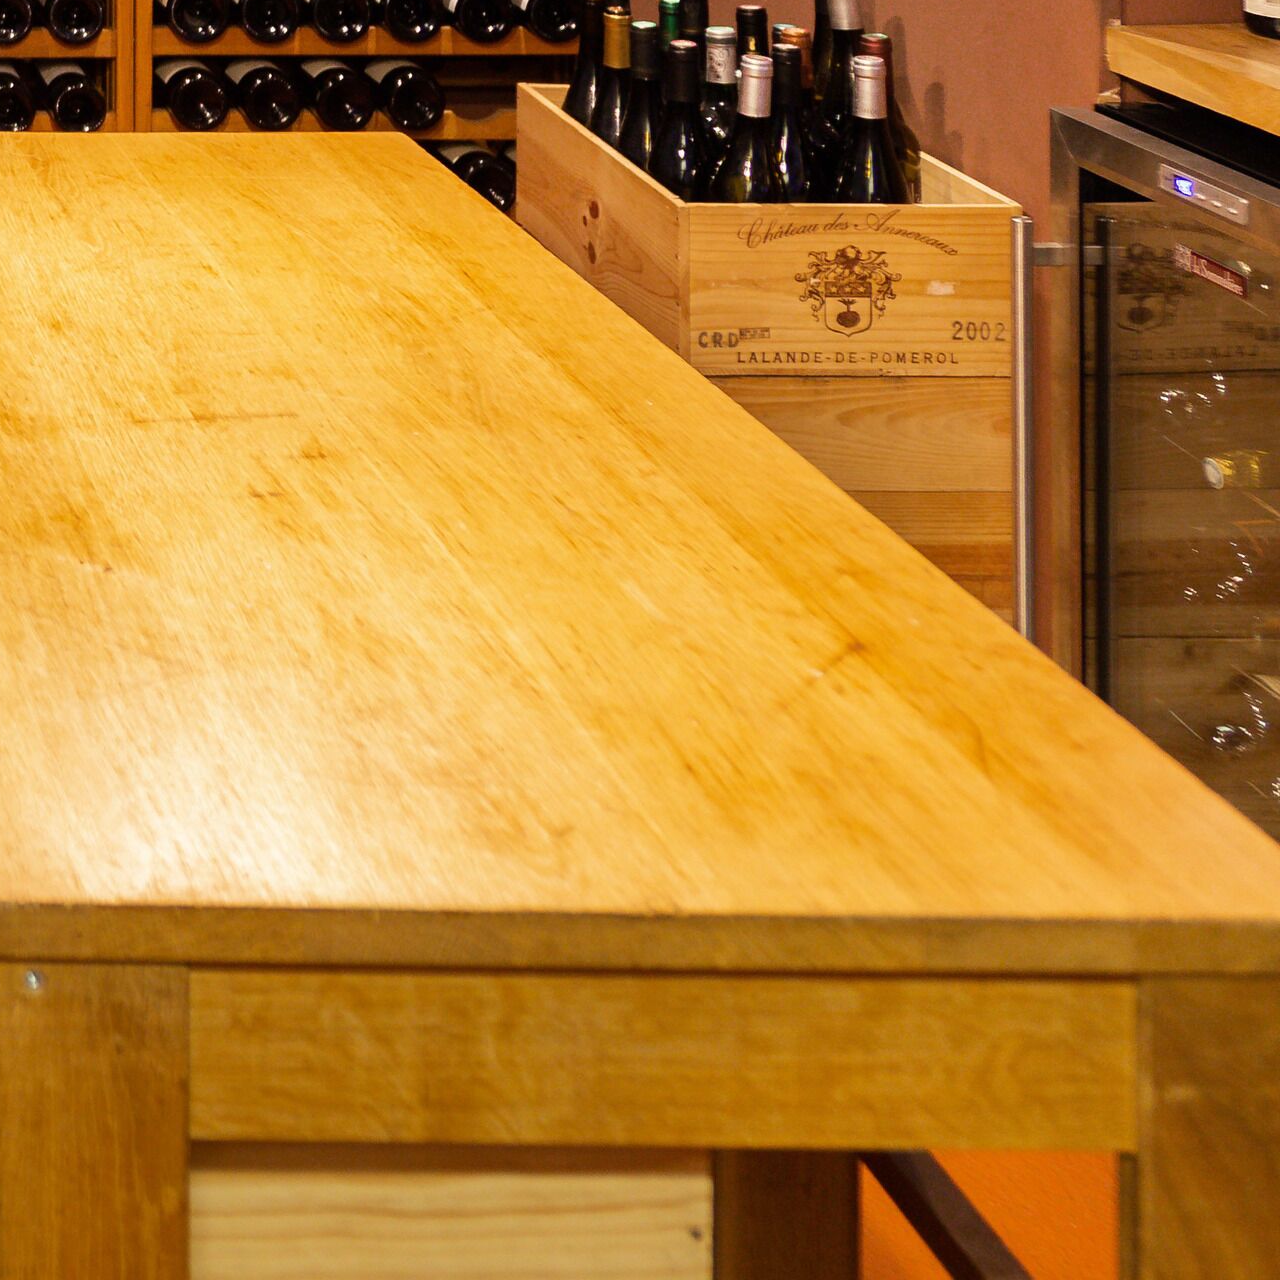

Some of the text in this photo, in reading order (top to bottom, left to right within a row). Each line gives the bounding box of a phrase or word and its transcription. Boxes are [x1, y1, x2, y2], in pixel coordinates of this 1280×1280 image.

[737, 217, 819, 249] Château
[823, 213, 849, 232] des
[698, 331, 740, 348] CRD
[952, 321, 1007, 341] 2002
[737, 351, 960, 365] LALANDE-DE-POMEROL
